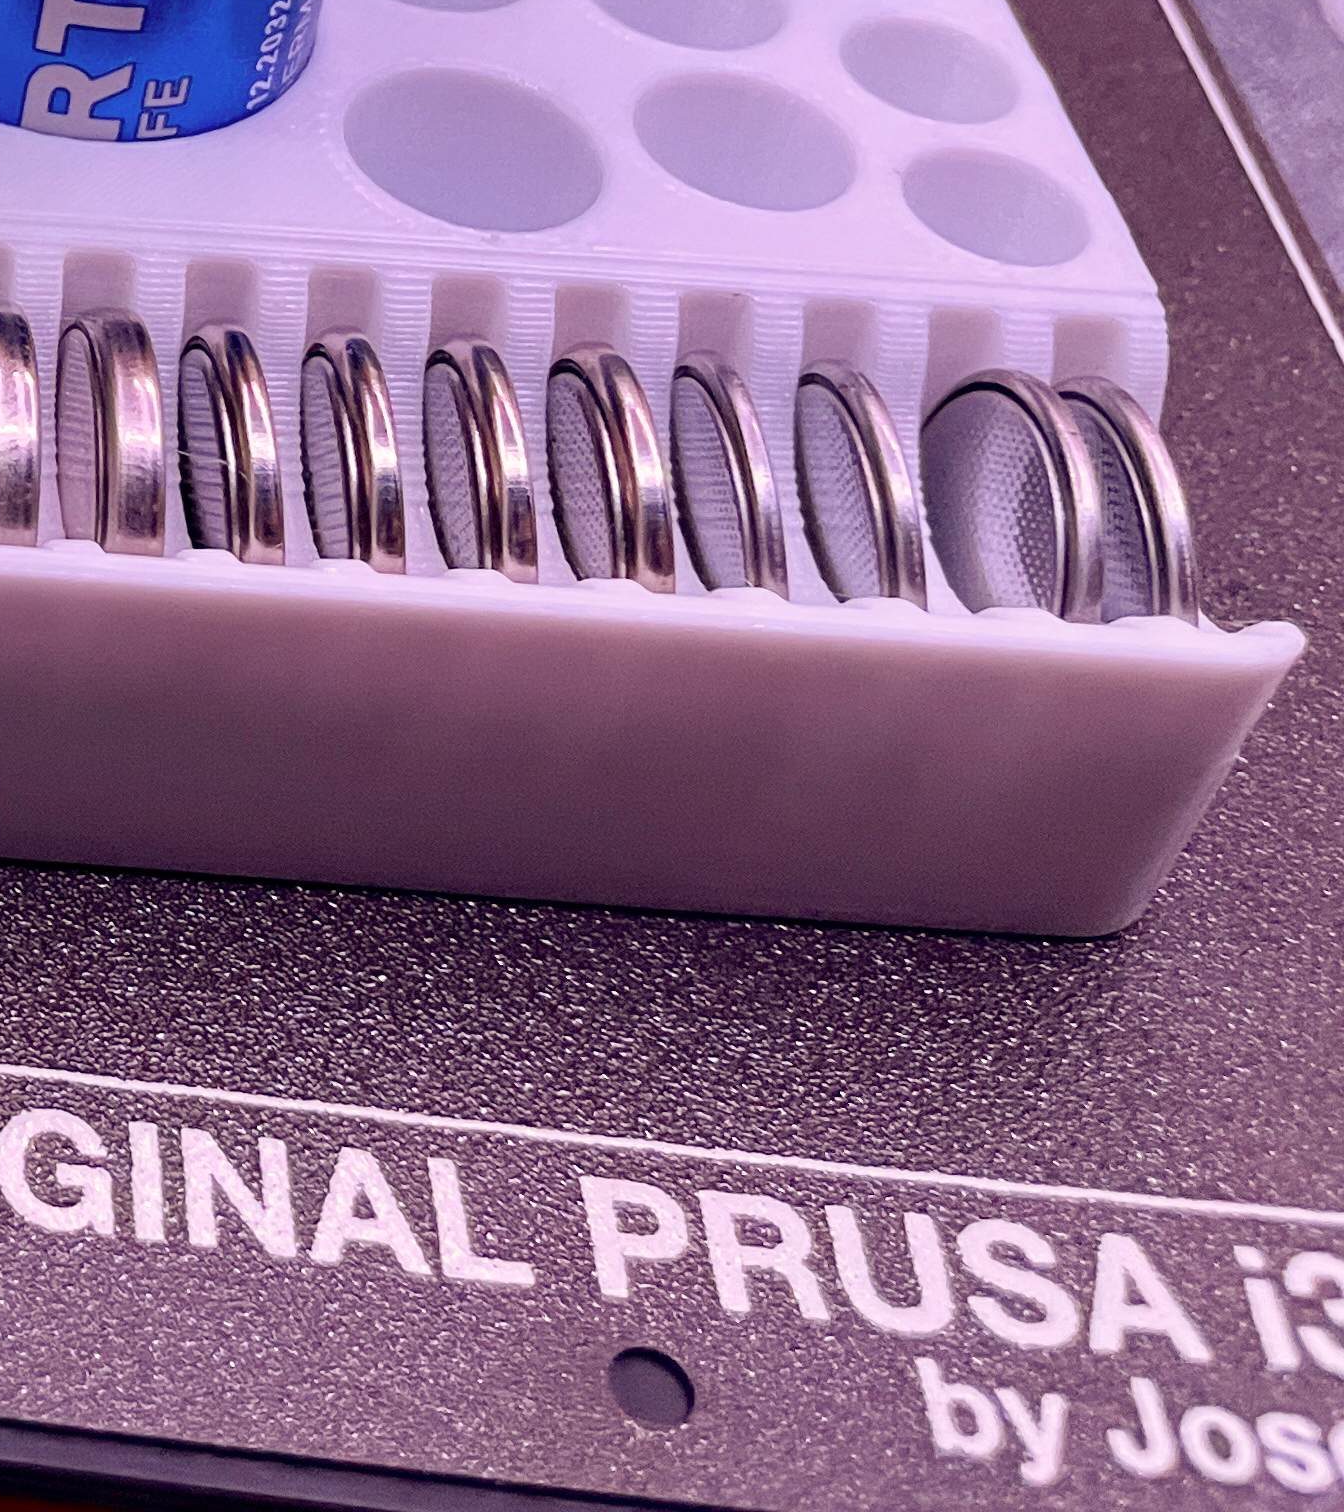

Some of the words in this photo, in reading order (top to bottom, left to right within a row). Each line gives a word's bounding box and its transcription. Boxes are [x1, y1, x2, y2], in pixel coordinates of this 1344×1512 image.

[578, 1175, 1212, 1365] PRUSA
[915, 1357, 1069, 1487] by
[1105, 1376, 1344, 1493] Jos
